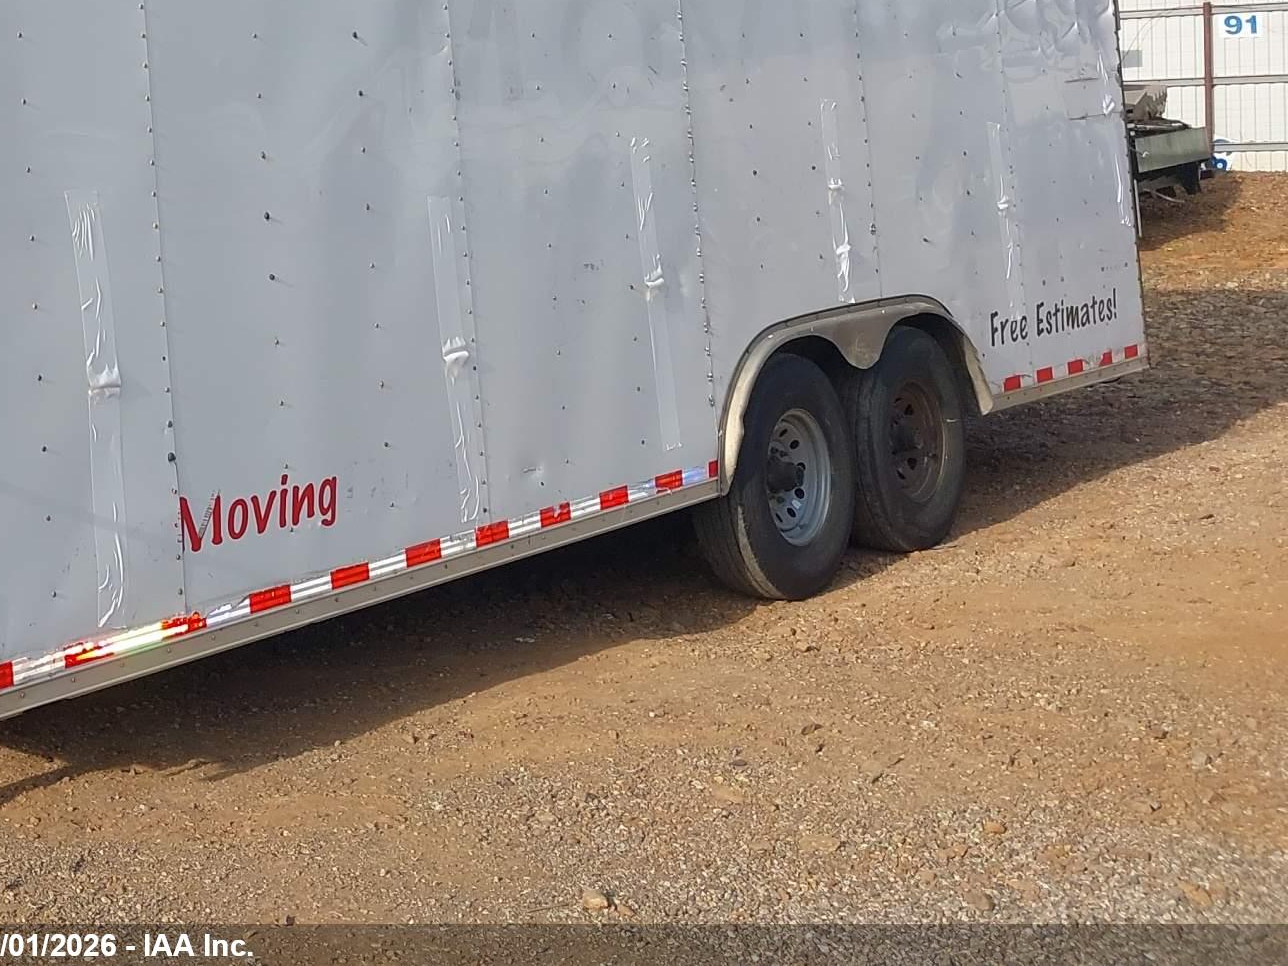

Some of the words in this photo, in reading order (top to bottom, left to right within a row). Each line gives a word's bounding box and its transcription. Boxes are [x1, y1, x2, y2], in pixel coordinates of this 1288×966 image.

[1223, 15, 1258, 35] 91
[990, 310, 1029, 347] Free
[1036, 288, 1118, 337] Estimates!
[179, 473, 337, 553] Moving
